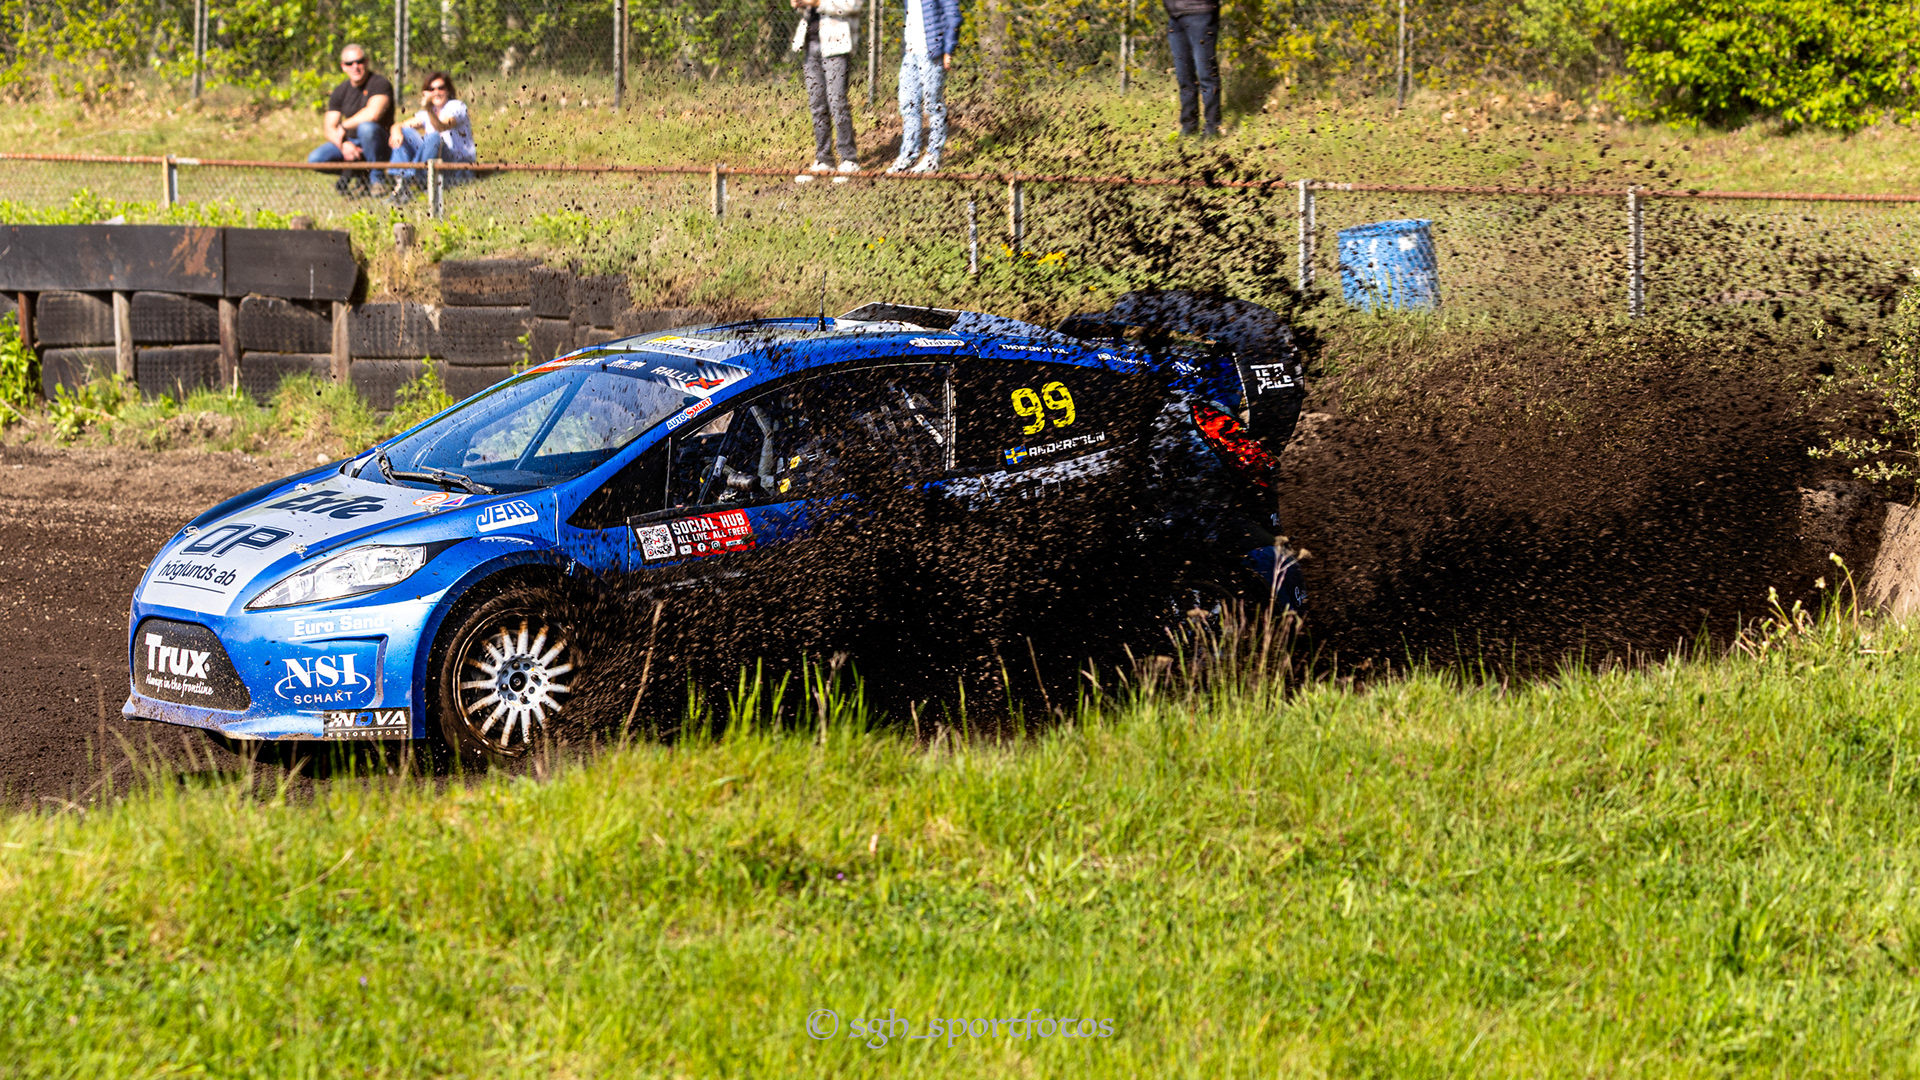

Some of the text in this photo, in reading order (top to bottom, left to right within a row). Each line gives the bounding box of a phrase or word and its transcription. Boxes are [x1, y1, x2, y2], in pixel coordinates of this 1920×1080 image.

[651, 366, 700, 382] RALLY
[666, 397, 713, 430] AUTOSMART
[1010, 381, 1076, 435] 99
[476, 500, 538, 528] JEAB
[671, 512, 746, 536] SOCIAL HUB
[677, 526, 749, 545] ALL LIVE. ALL FREE!
[158, 560, 237, 587] höglunds ab
[294, 613, 385, 637] Euro Sand
[145, 632, 211, 680] Trux
[281, 653, 361, 690] NSI
[170, 677, 182, 691] the
[180, 678, 215, 698] frontline
[293, 691, 353, 705] SCHAKT
[327, 729, 408, 738] MOTORSPORT
